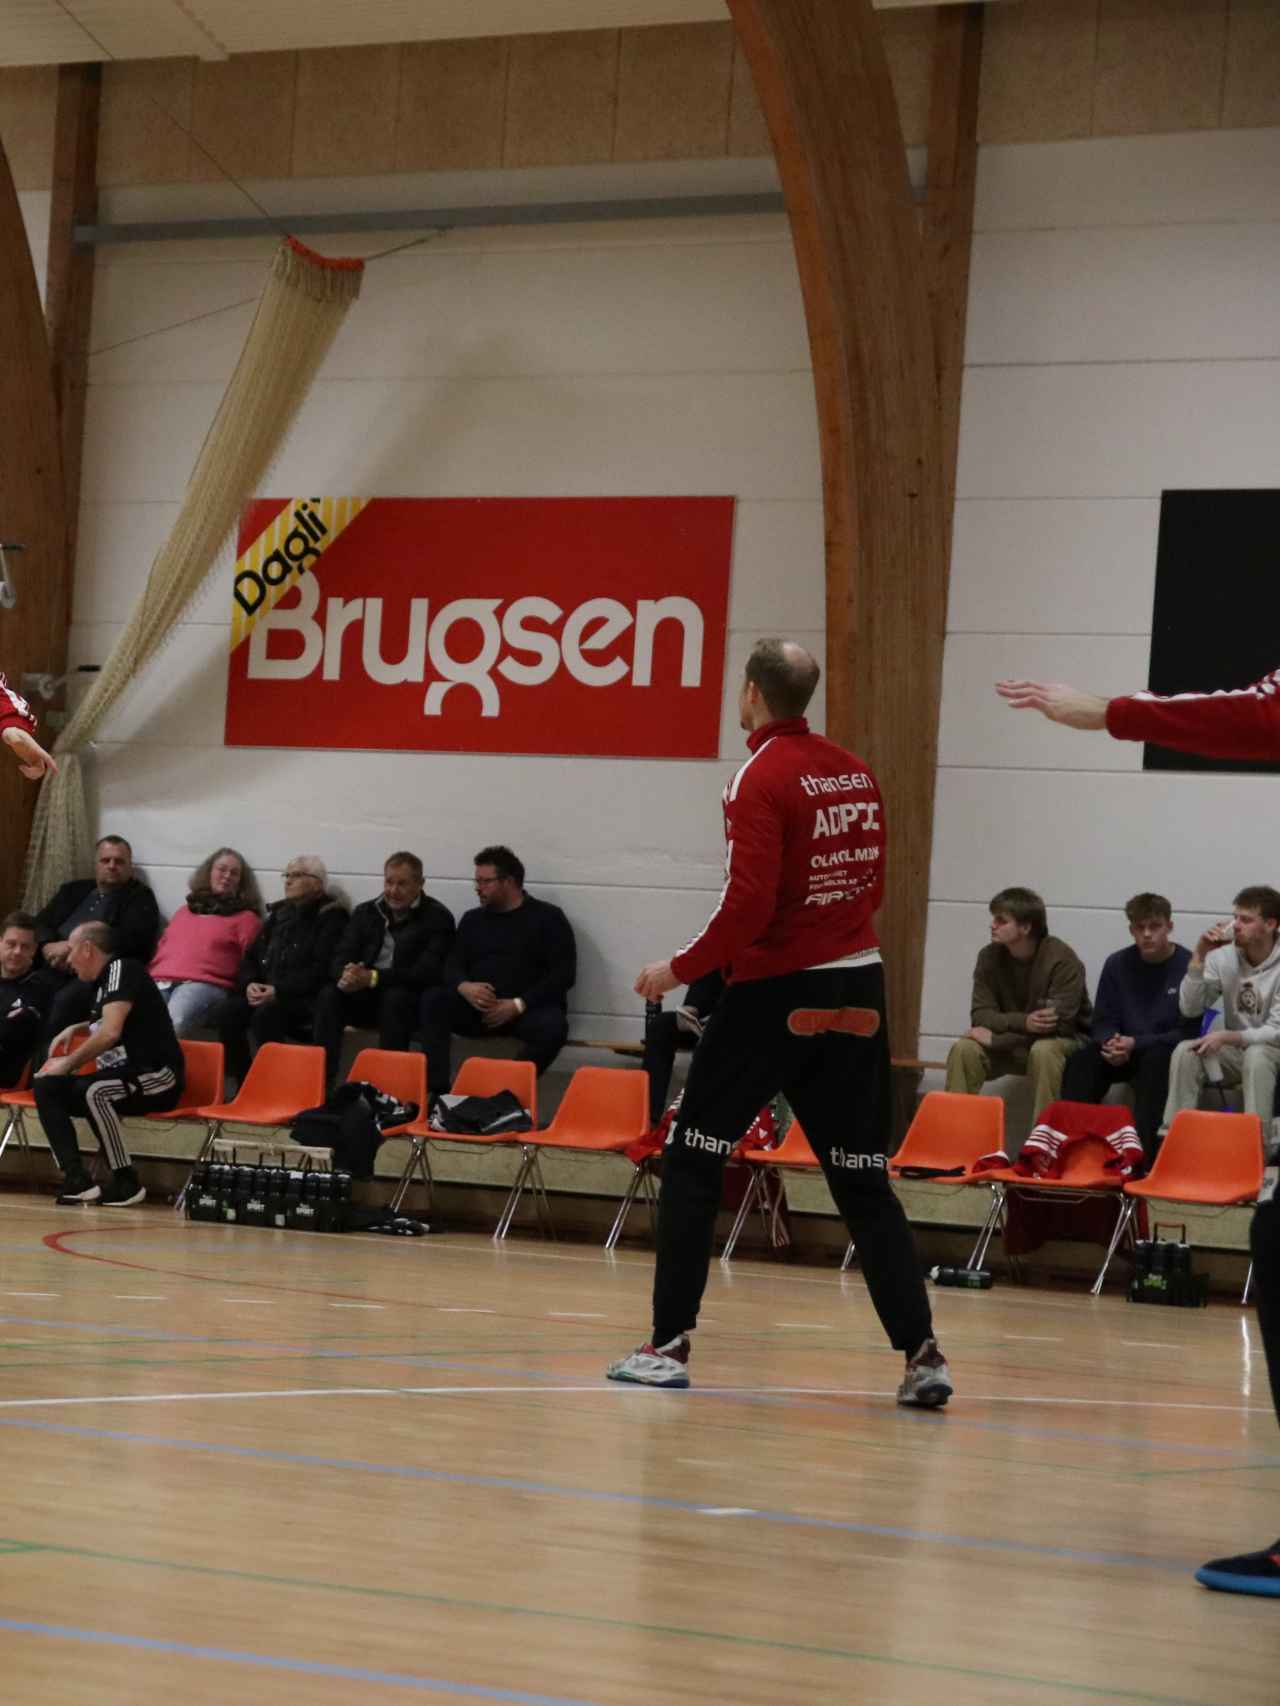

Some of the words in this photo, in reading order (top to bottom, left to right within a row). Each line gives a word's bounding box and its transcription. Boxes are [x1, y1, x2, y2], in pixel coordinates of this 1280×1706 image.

[247, 567, 705, 718] Brugsen
[800, 773, 875, 796] thansen
[684, 1127, 738, 1155] than
